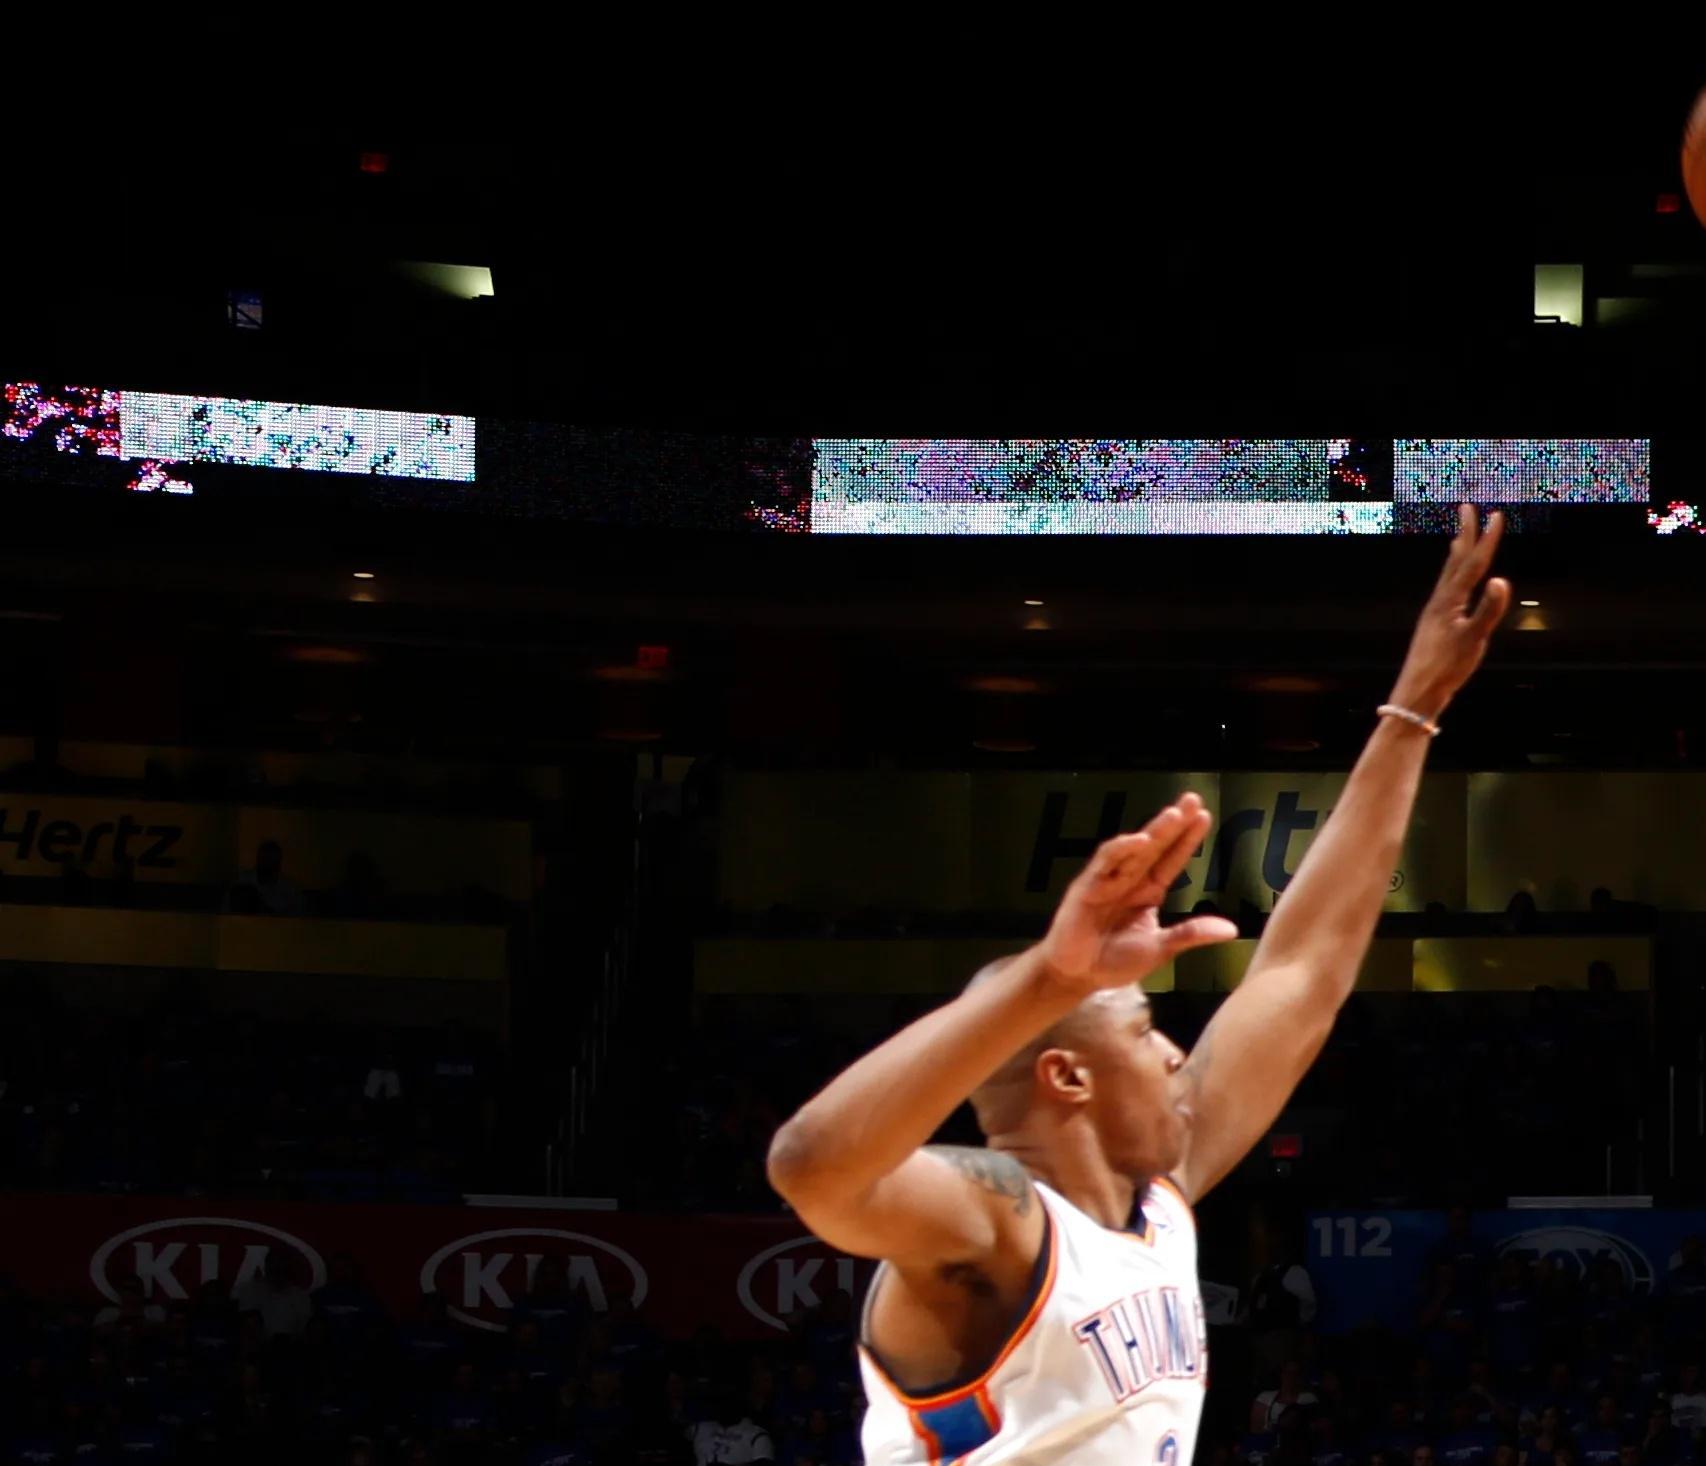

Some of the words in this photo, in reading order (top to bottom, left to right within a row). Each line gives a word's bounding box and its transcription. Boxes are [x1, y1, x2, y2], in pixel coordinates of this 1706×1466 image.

[0, 809, 183, 867] Hertz
[1311, 1216, 1393, 1258] 112
[461, 1252, 609, 1313] KIA
[774, 1257, 856, 1314] KI
[1072, 1286, 1209, 1403] THUN
